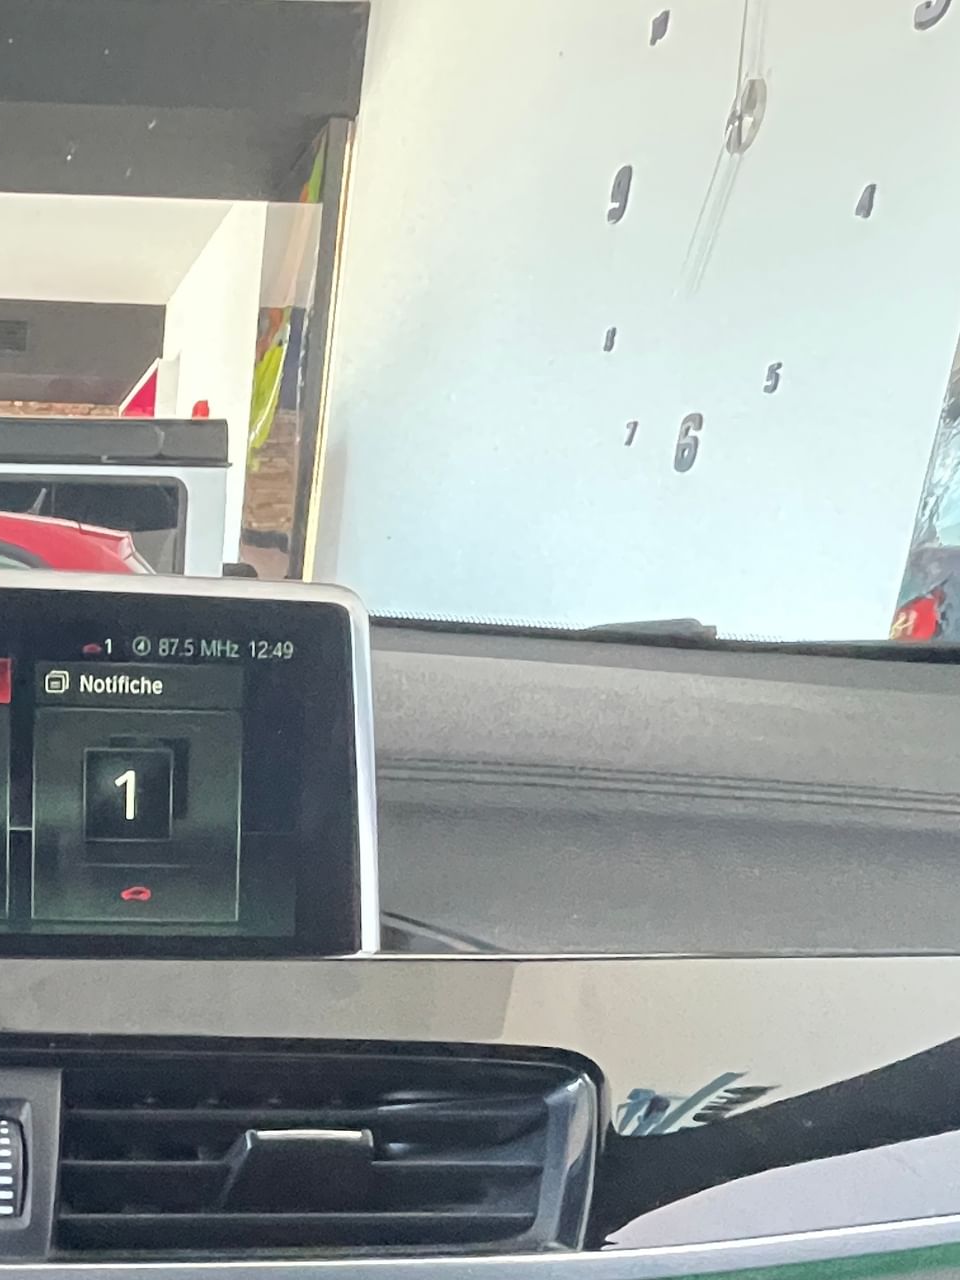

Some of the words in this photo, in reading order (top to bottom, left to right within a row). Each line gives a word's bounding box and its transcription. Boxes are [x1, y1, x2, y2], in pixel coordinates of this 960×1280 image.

[607, 165, 633, 225] 9
[763, 362, 783, 394] 5
[673, 412, 704, 473] 6
[104, 638, 112, 654] 1
[158, 637, 194, 657] 87.5
[200, 639, 240, 658] MHz
[249, 640, 294, 659] 12:49
[79, 674, 163, 695] Notifiche
[114, 770, 136, 820] 1
